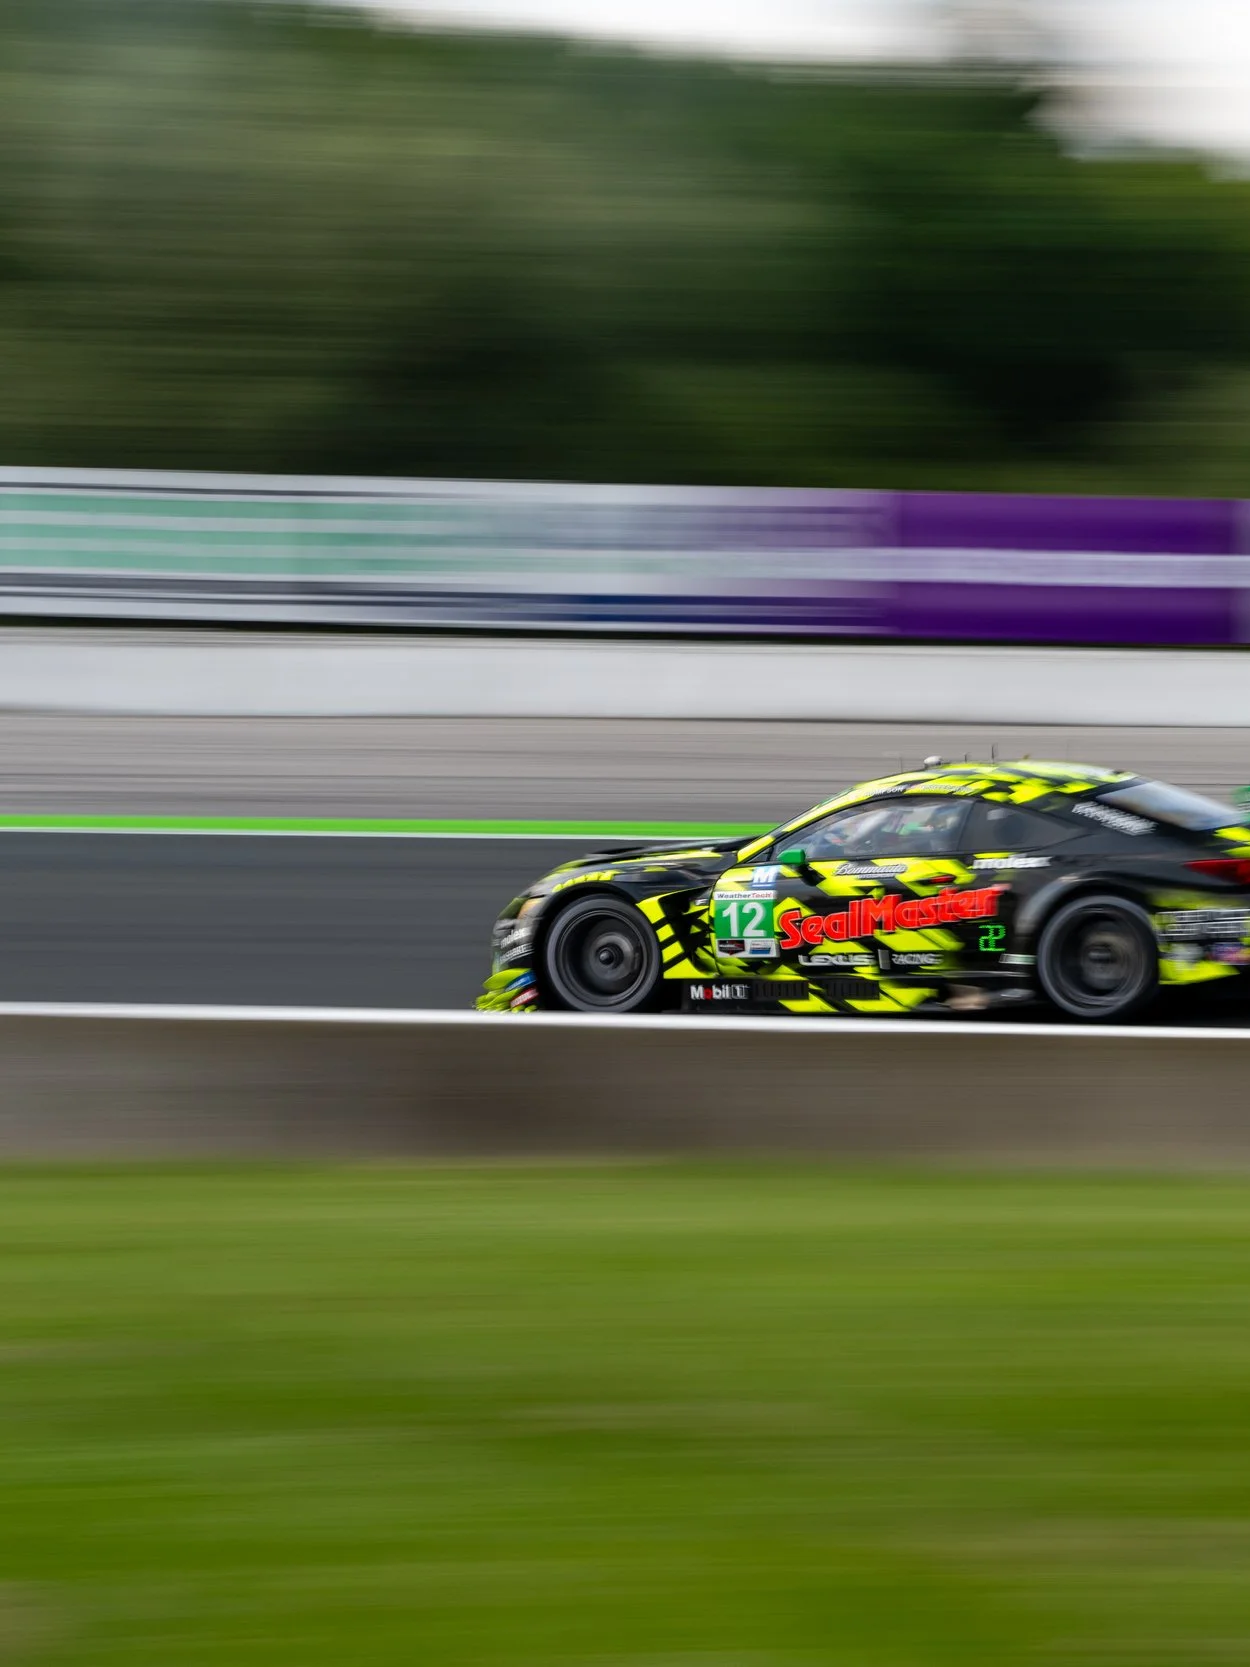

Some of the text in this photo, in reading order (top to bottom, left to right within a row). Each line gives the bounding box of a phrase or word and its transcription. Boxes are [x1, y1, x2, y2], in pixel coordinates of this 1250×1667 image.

[722, 902, 768, 937] 12
[779, 887, 1001, 949] SealMaster
[798, 953, 943, 966] LEXUS RACING
[690, 985, 729, 999] Mobil
